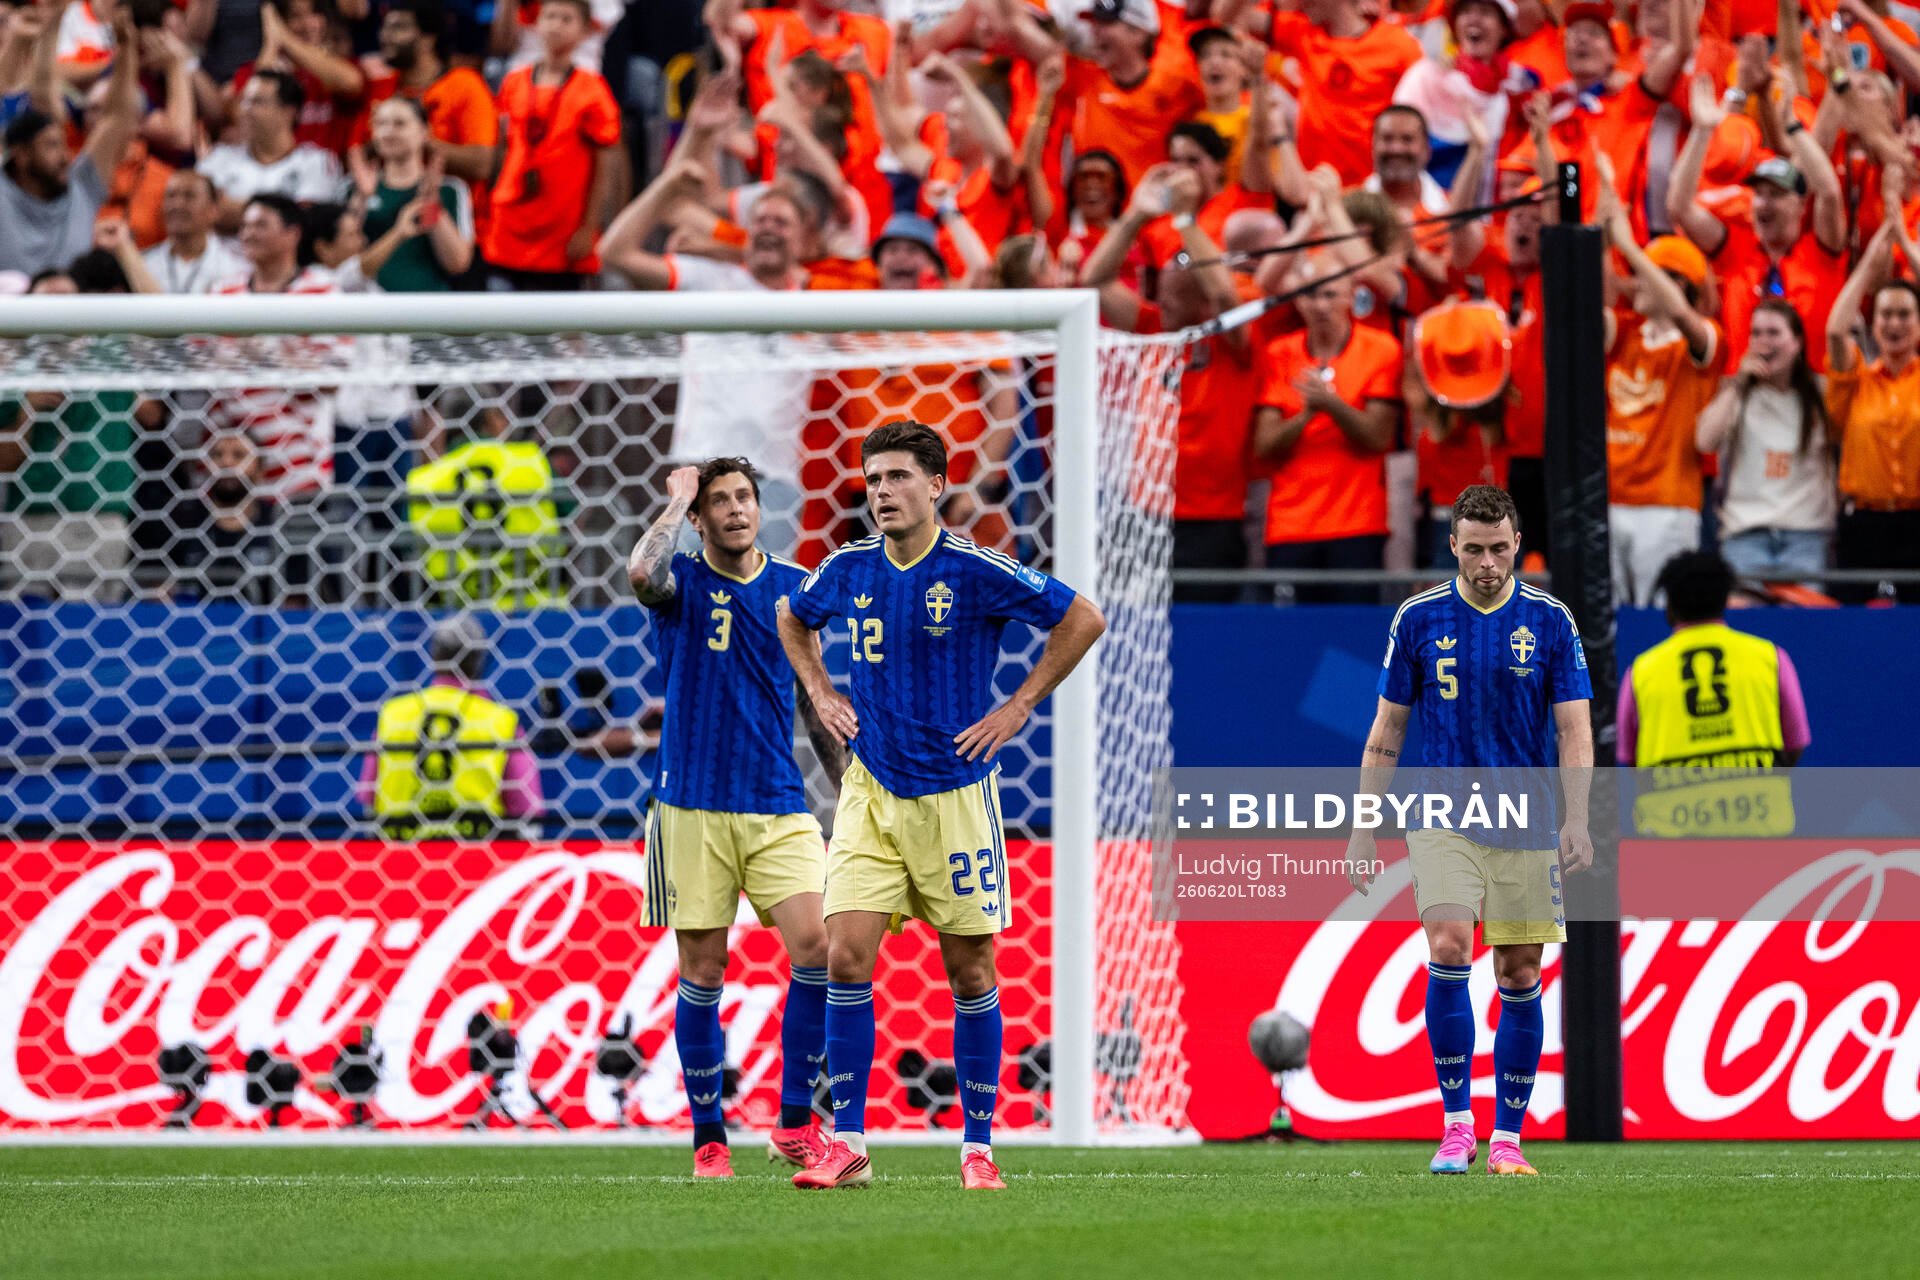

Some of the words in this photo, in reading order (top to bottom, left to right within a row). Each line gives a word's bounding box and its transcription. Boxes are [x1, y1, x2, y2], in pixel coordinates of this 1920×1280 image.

[708, 608, 733, 652] 3
[1436, 657, 1459, 700] 5
[1671, 793, 1770, 829] 06195
[949, 848, 997, 896] 22
